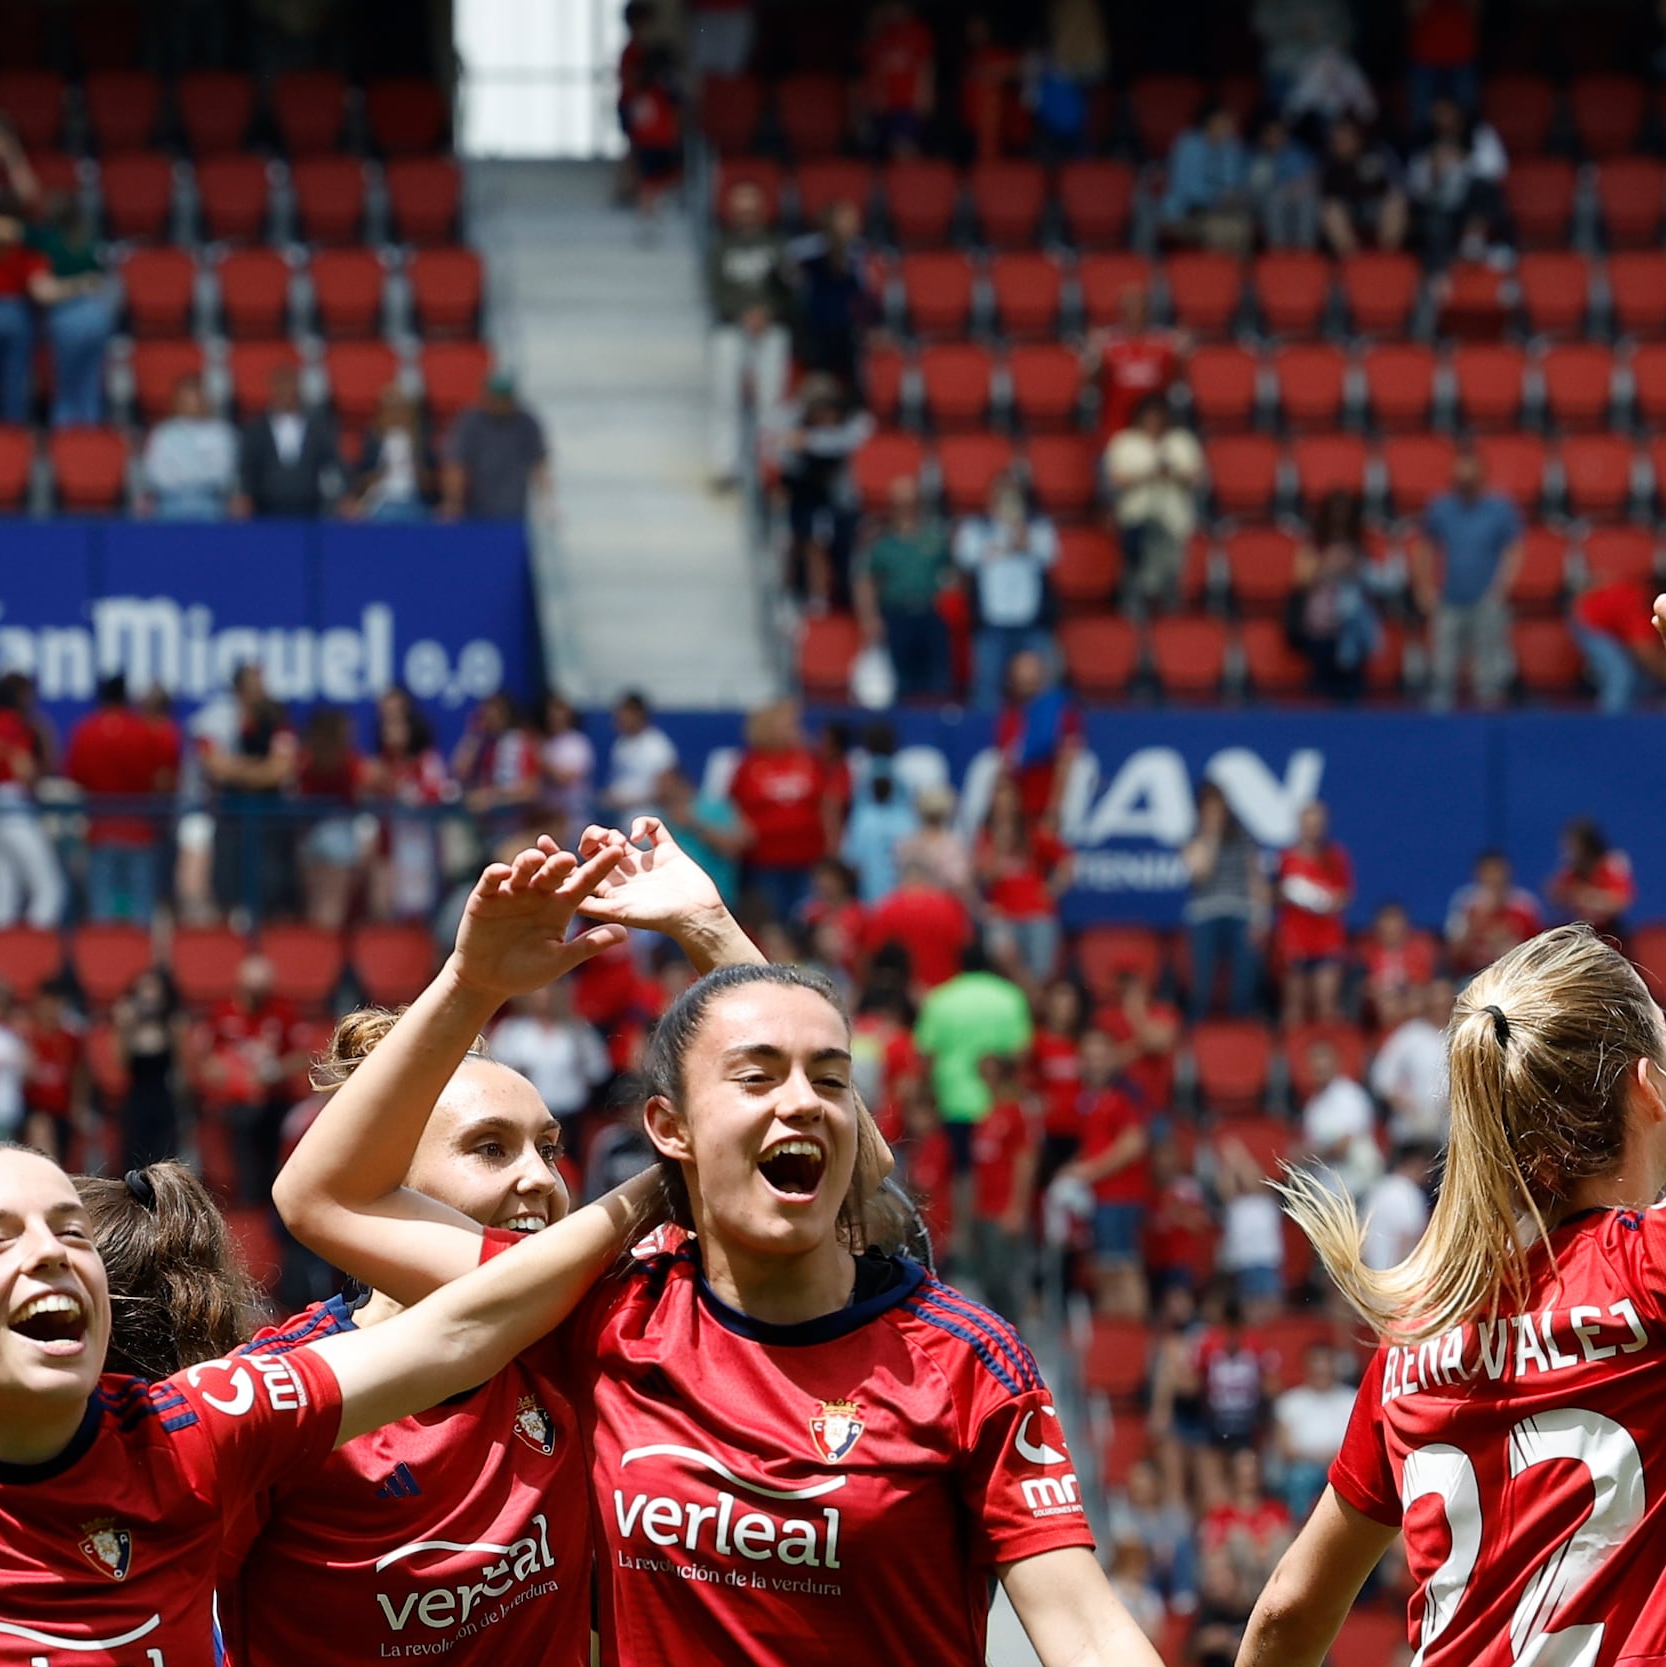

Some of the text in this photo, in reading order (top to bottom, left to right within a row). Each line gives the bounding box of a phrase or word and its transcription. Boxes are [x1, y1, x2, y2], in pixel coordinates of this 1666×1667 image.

[1380, 1298, 1649, 1407] ELENA VALEJ
[1020, 1473, 1077, 1509] mr
[614, 1489, 841, 1569] verleal
[618, 1550, 633, 1568] La
[724, 1568, 747, 1588] de
[751, 1571, 766, 1589] la
[771, 1577, 841, 1596] verdura
[381, 1642, 401, 1657] La
[480, 1612, 500, 1628] de
